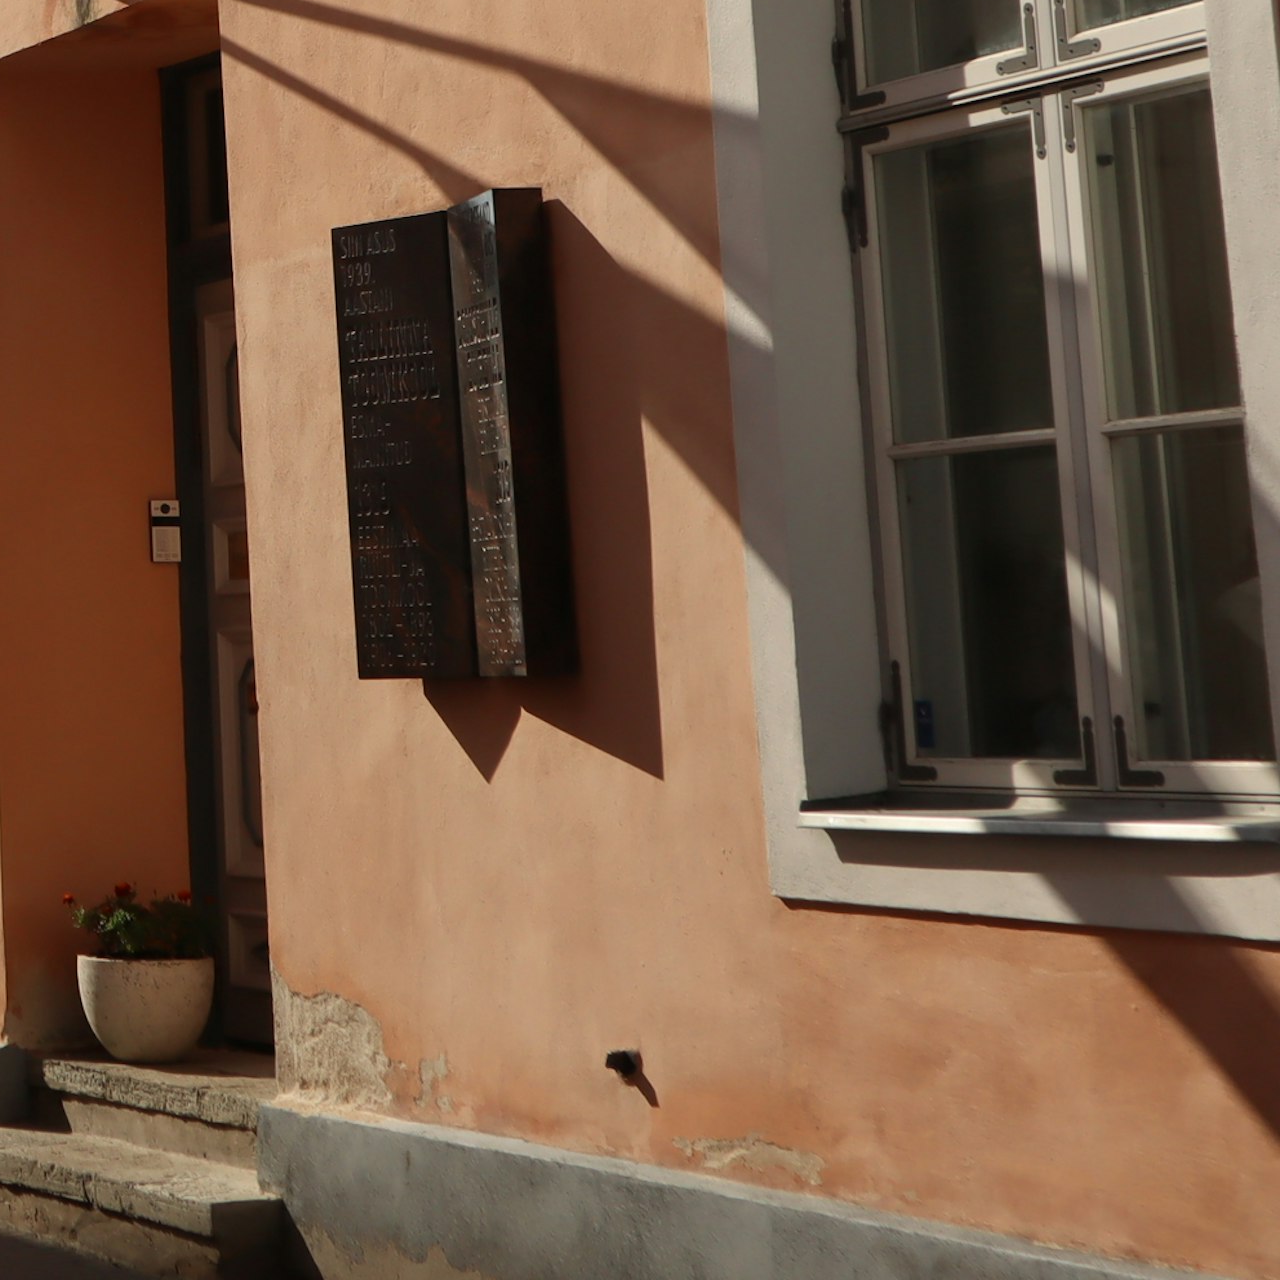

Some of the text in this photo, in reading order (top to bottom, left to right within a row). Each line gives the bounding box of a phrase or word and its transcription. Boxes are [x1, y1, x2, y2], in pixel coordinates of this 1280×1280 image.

[340, 228, 397, 260] SIIN ASUS
[344, 320, 435, 363] TALLINNA
[347, 363, 441, 408] TOOMKOOL
